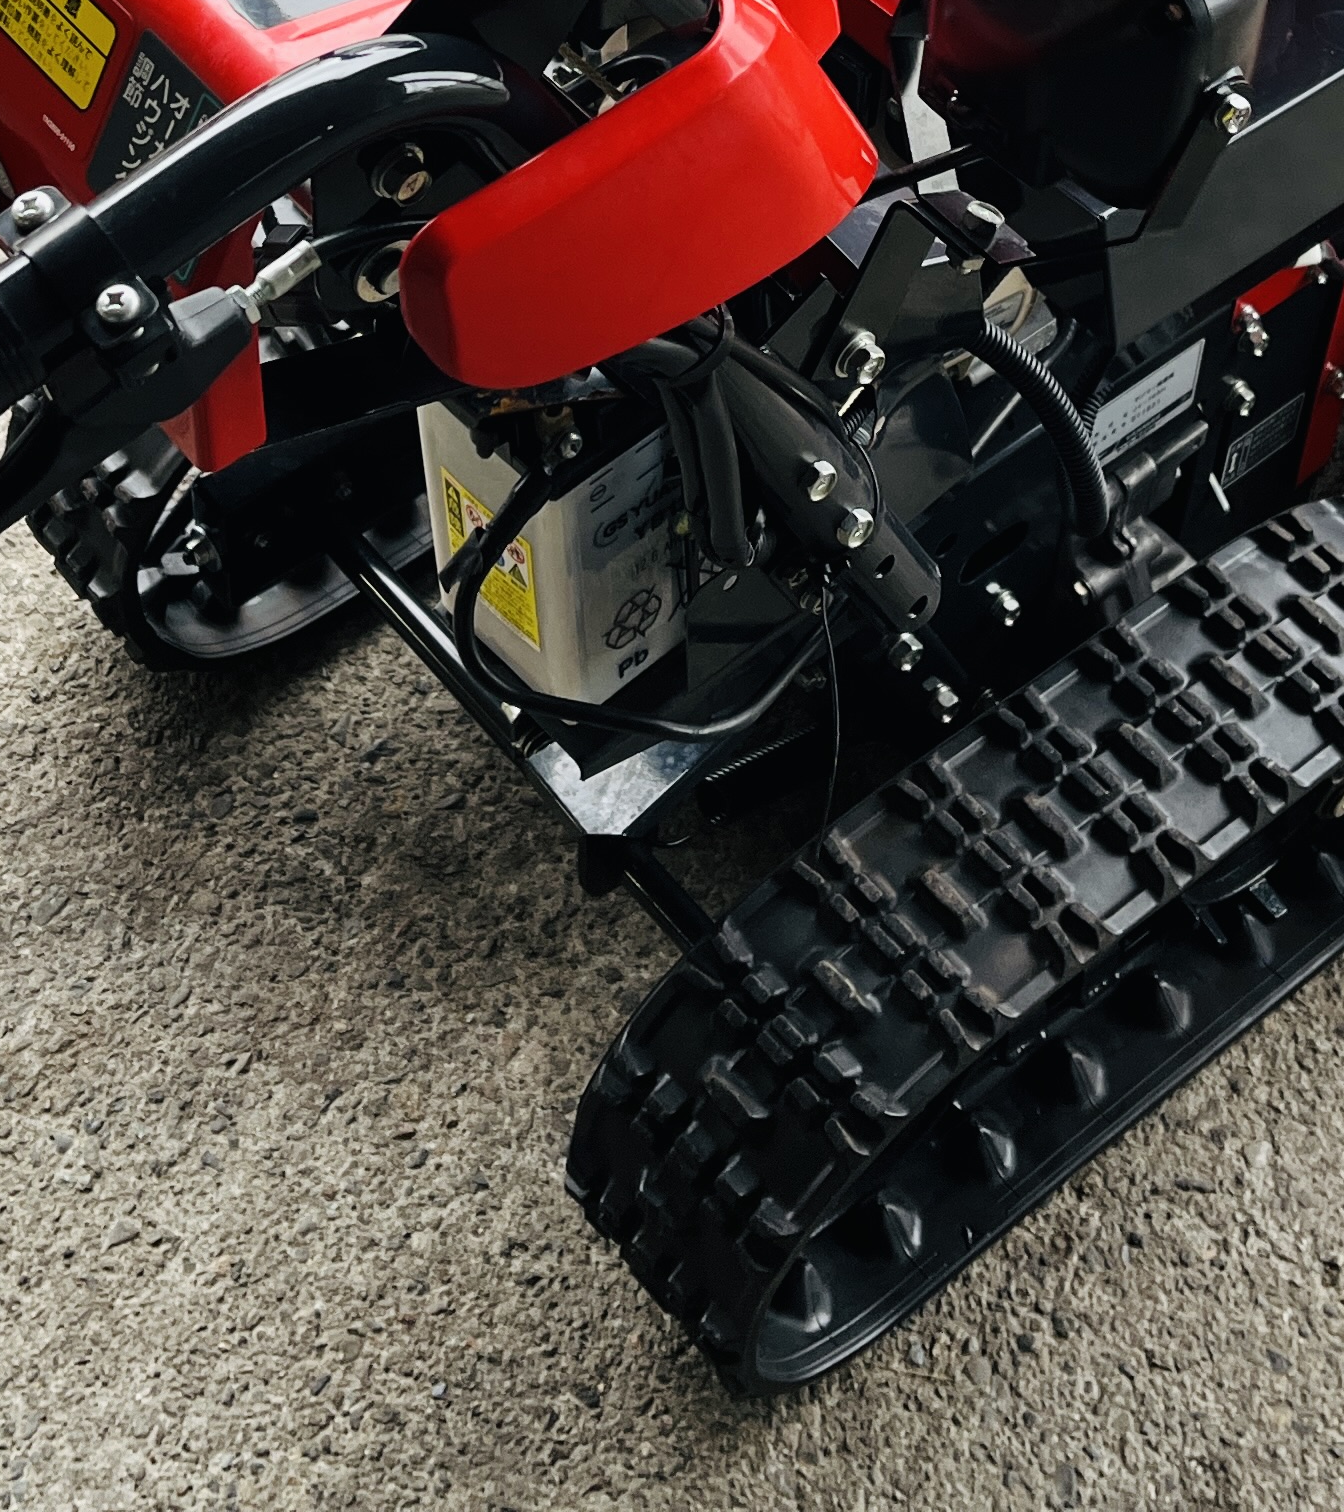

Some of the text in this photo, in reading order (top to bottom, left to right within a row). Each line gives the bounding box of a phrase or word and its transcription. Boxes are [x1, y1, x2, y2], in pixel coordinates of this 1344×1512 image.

[123, 51, 155, 109] 調節
[114, 74, 170, 181] ハウジン
[618, 648, 649, 679] Pb
